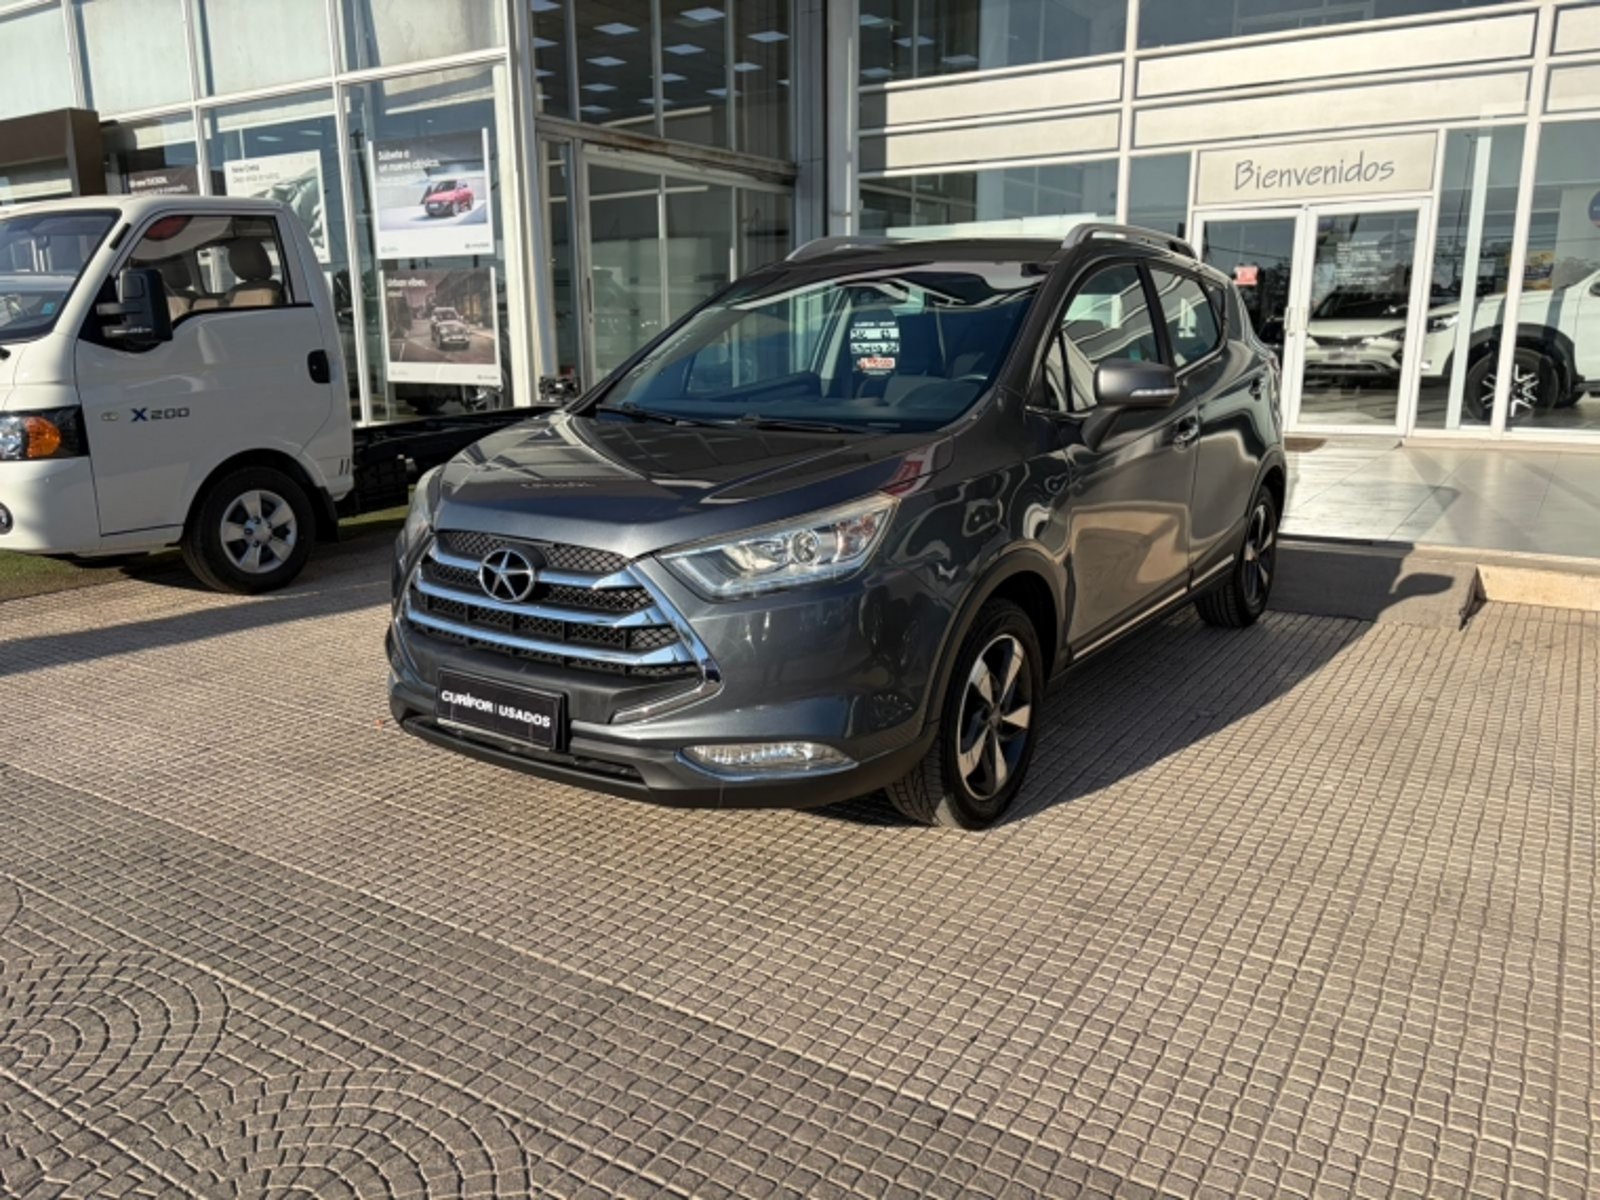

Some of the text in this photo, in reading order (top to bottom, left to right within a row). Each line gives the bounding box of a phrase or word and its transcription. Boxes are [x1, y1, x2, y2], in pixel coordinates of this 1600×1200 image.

[1234, 150, 1395, 190] Bienvenidos
[130, 406, 190, 422] X200
[498, 704, 551, 728] USADOS
